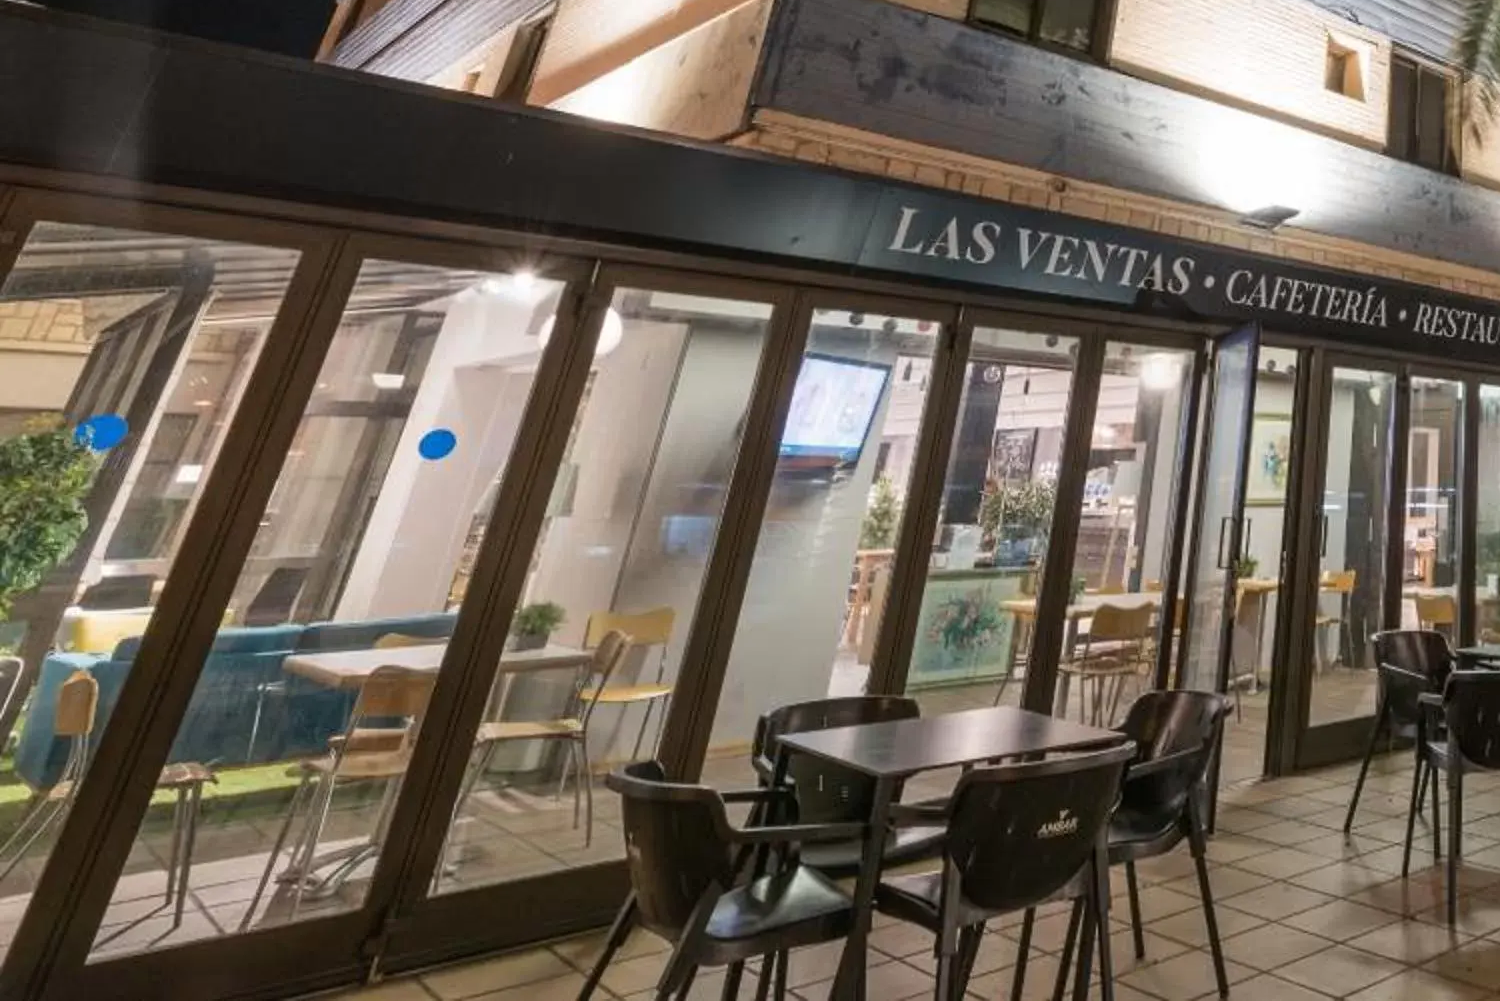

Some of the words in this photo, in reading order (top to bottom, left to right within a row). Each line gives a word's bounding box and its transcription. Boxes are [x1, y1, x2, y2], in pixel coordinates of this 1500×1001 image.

[887, 205, 1001, 265] LAS
[1016, 227, 1195, 296] VENTAS
[1224, 269, 1389, 329] CAFETERÍA
